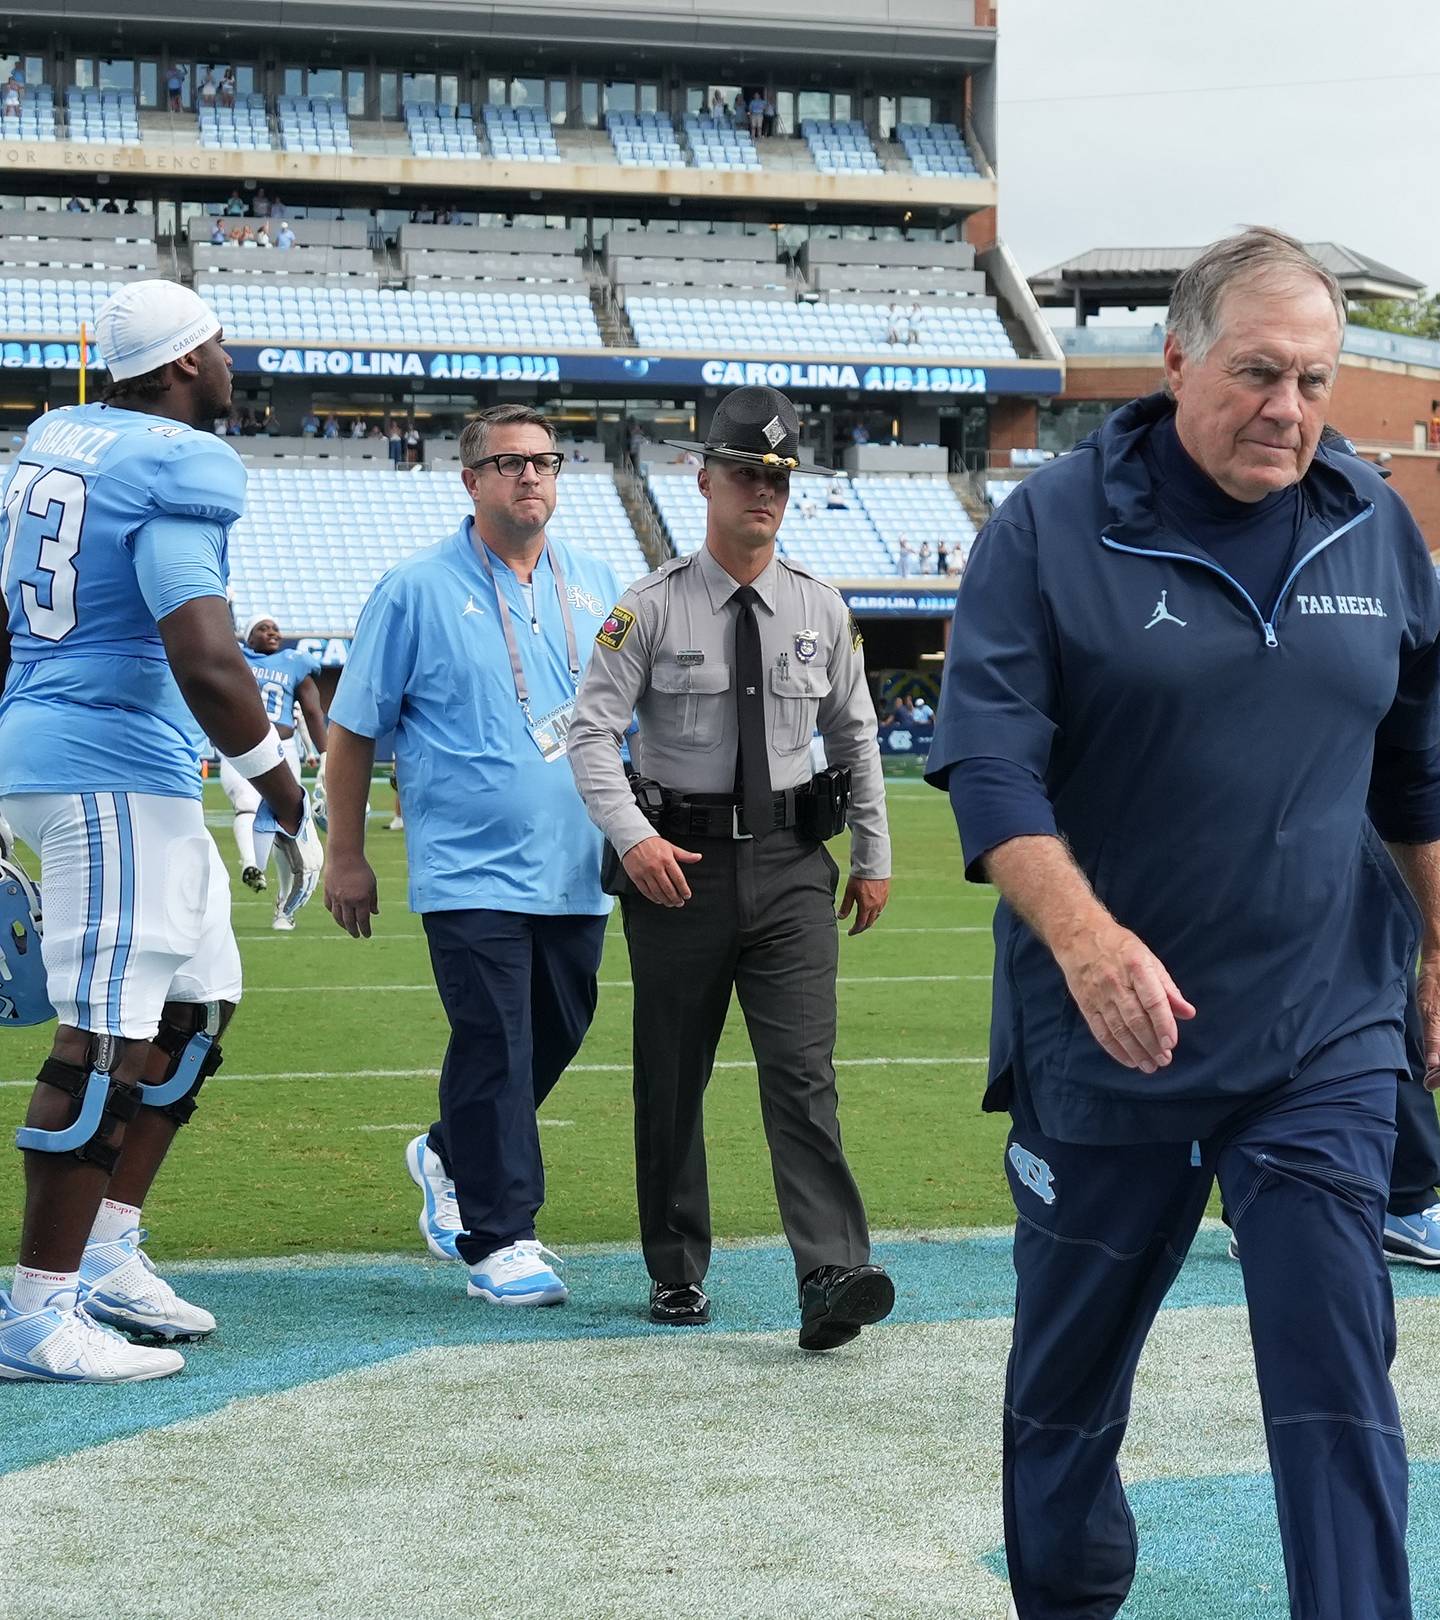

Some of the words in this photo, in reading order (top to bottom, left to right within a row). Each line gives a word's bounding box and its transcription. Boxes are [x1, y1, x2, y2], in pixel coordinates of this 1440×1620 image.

[63, 151, 218, 170] EXCELLENCE
[172, 324, 210, 352] CAROLINA
[257, 347, 426, 376] CAROLINA
[701, 360, 860, 388] CAROLINA
[2, 461, 87, 644] 73
[848, 596, 917, 609] CAROLINA
[1296, 594, 1336, 615] TAR
[250, 666, 289, 685] ROLINA
